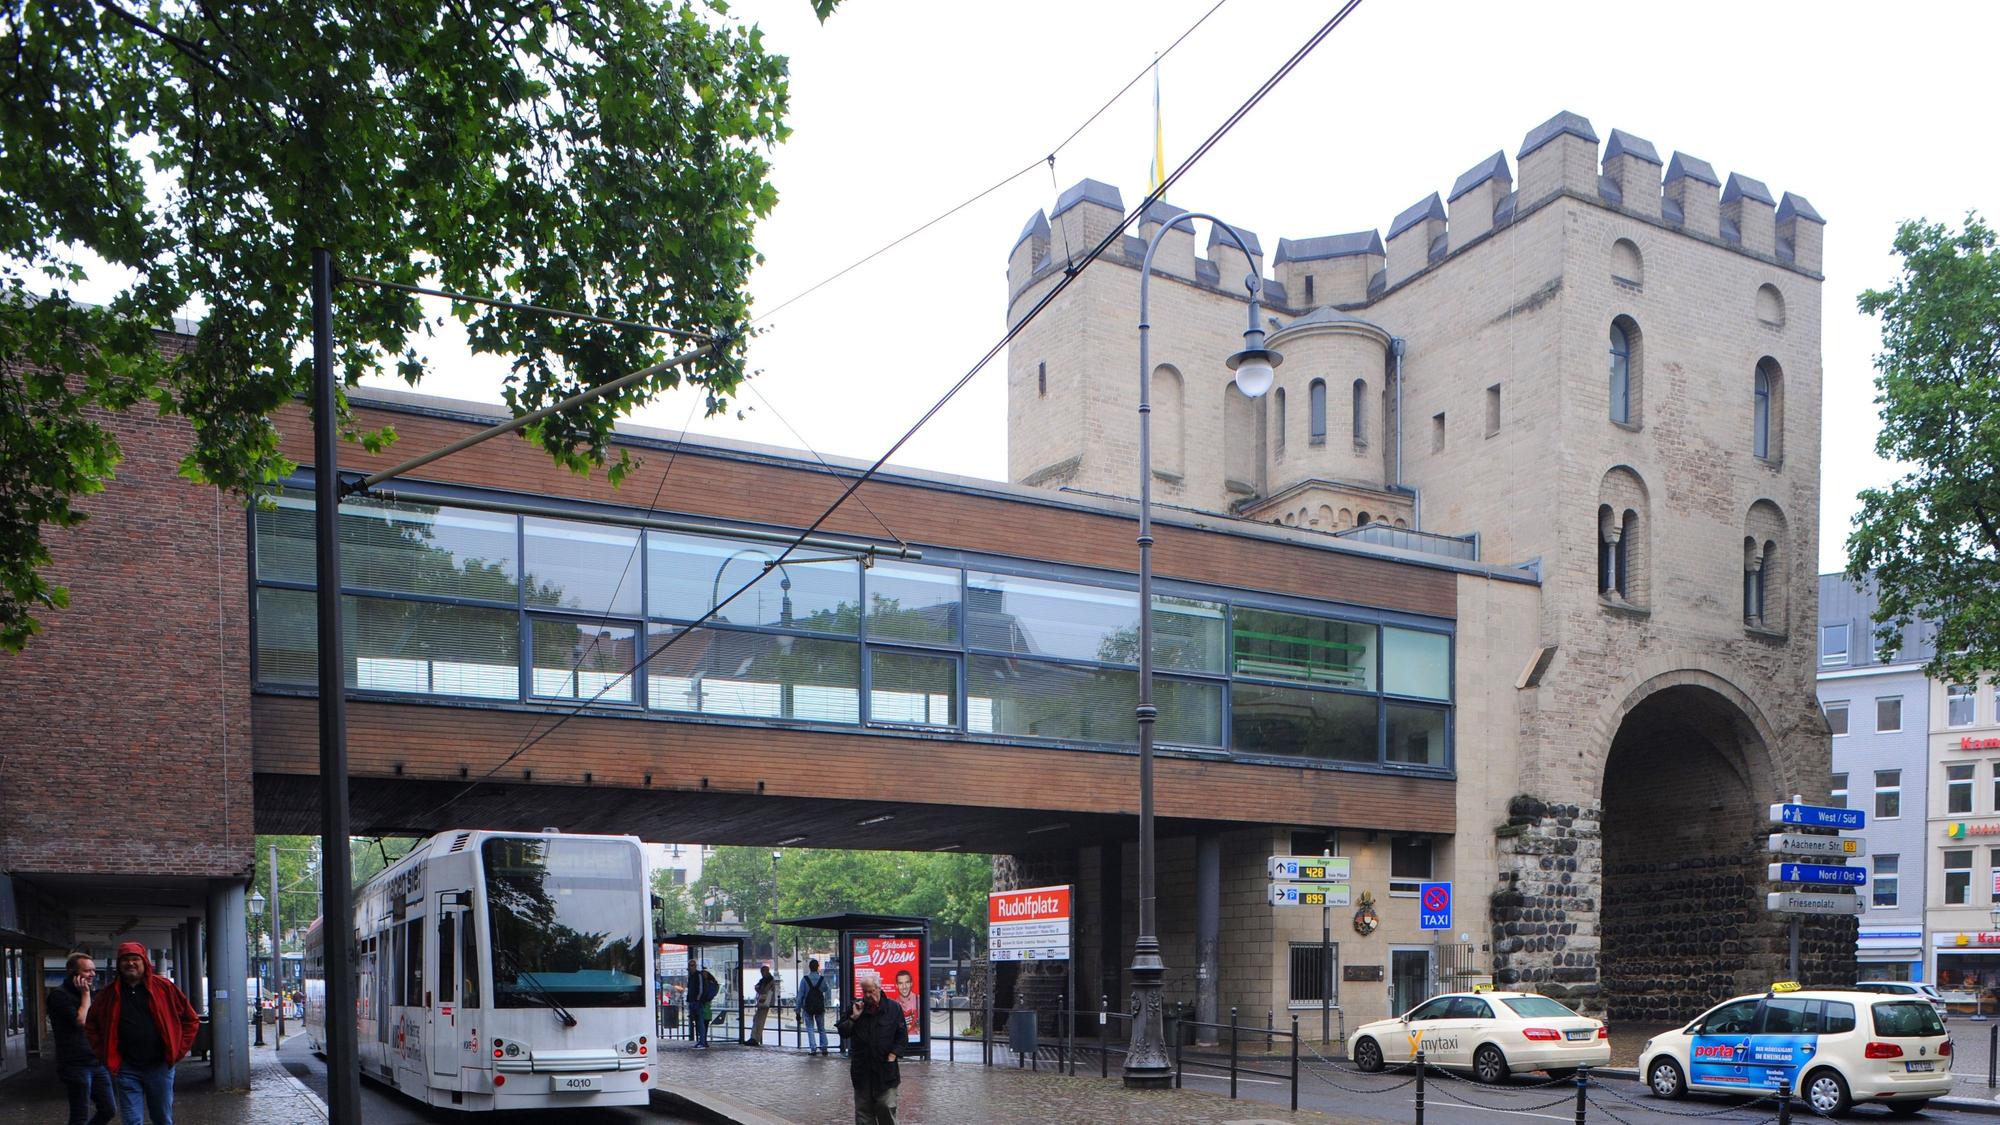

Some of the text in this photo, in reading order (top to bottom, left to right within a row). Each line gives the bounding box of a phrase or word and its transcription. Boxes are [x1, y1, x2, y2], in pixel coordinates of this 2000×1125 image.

[1818, 811, 1837, 823] West
[1843, 813, 1857, 824] Süd
[1790, 839, 1841, 851] Aachener Str.
[1846, 842, 1854, 851] 55
[1306, 867, 1324, 878] 428
[1818, 870, 1837, 880] Nord
[1843, 871, 1856, 881] Ost
[1305, 893, 1324, 904] 899
[1788, 897, 1836, 908] Friesenplatz
[998, 895, 1059, 918] Rudolfplatz
[1423, 915, 1448, 926] TAXI
[872, 949, 916, 966] Wiesn
[1420, 1035, 1459, 1054] mytaxi
[1695, 1044, 1734, 1057] porta
[567, 1078, 591, 1088] 4010
